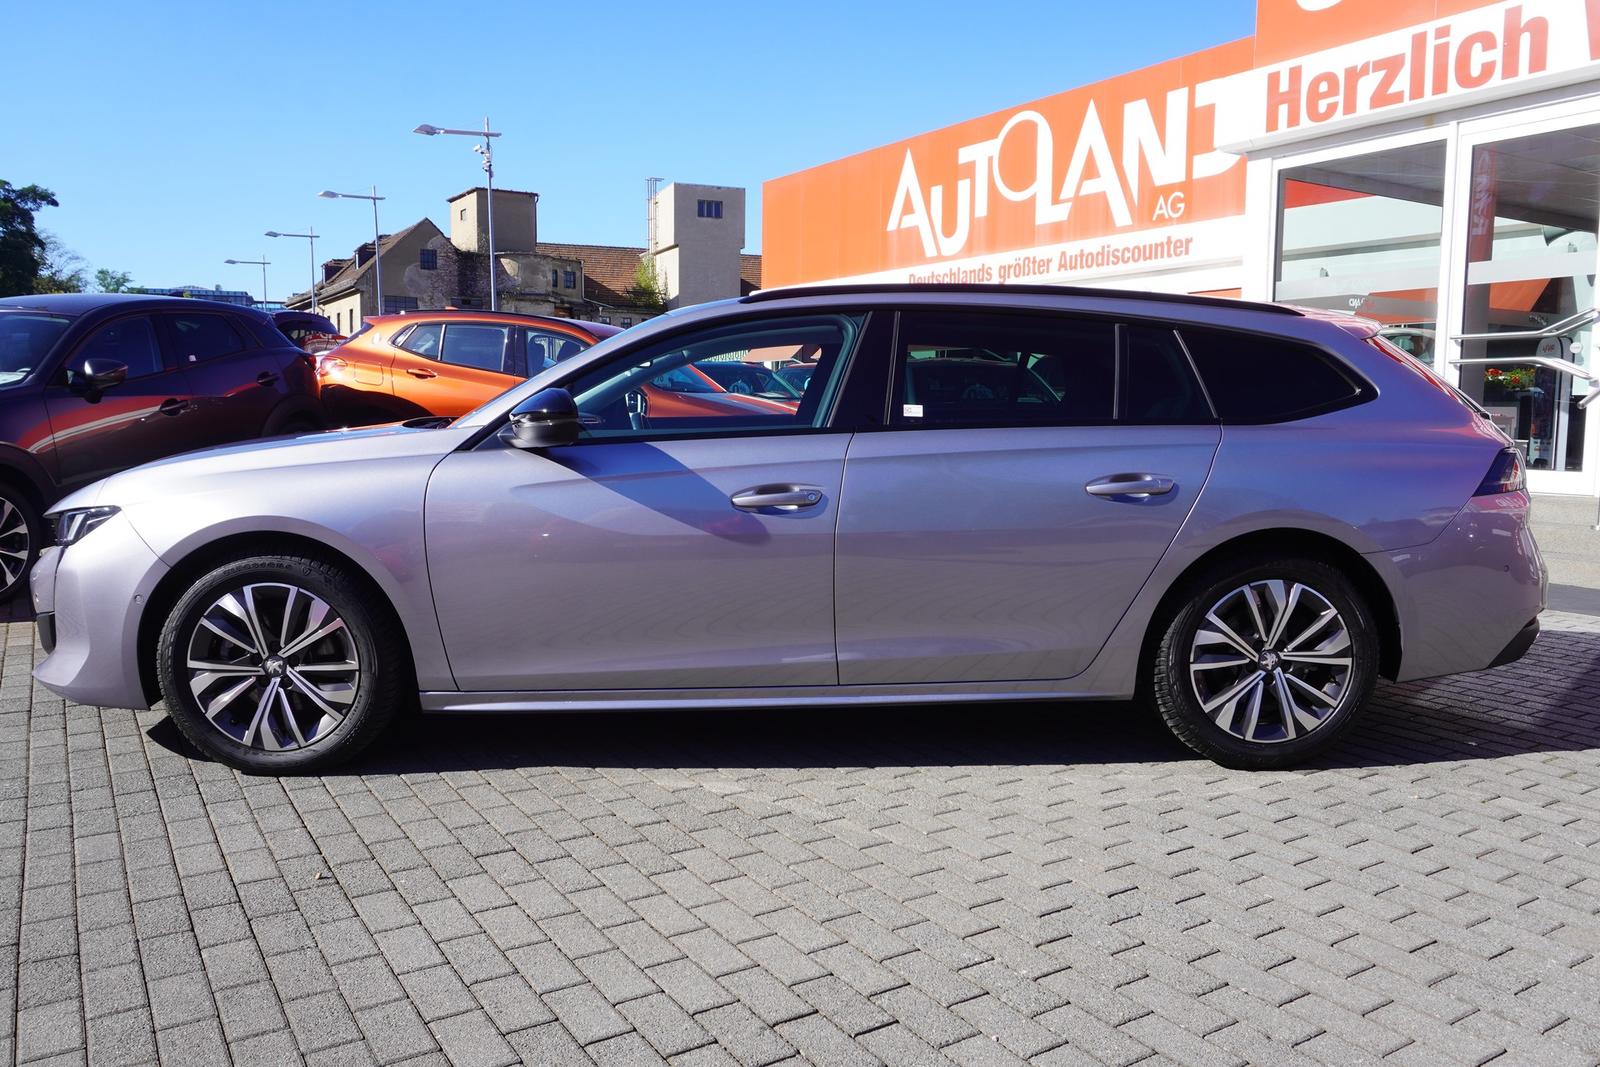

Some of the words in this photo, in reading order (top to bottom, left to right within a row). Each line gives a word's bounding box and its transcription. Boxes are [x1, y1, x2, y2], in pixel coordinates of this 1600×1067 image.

[1265, 5, 1549, 133] Herzlich
[1152, 191, 1185, 221] AG
[998, 256, 1053, 284] größter
[1057, 235, 1193, 272] Autodiscounter
